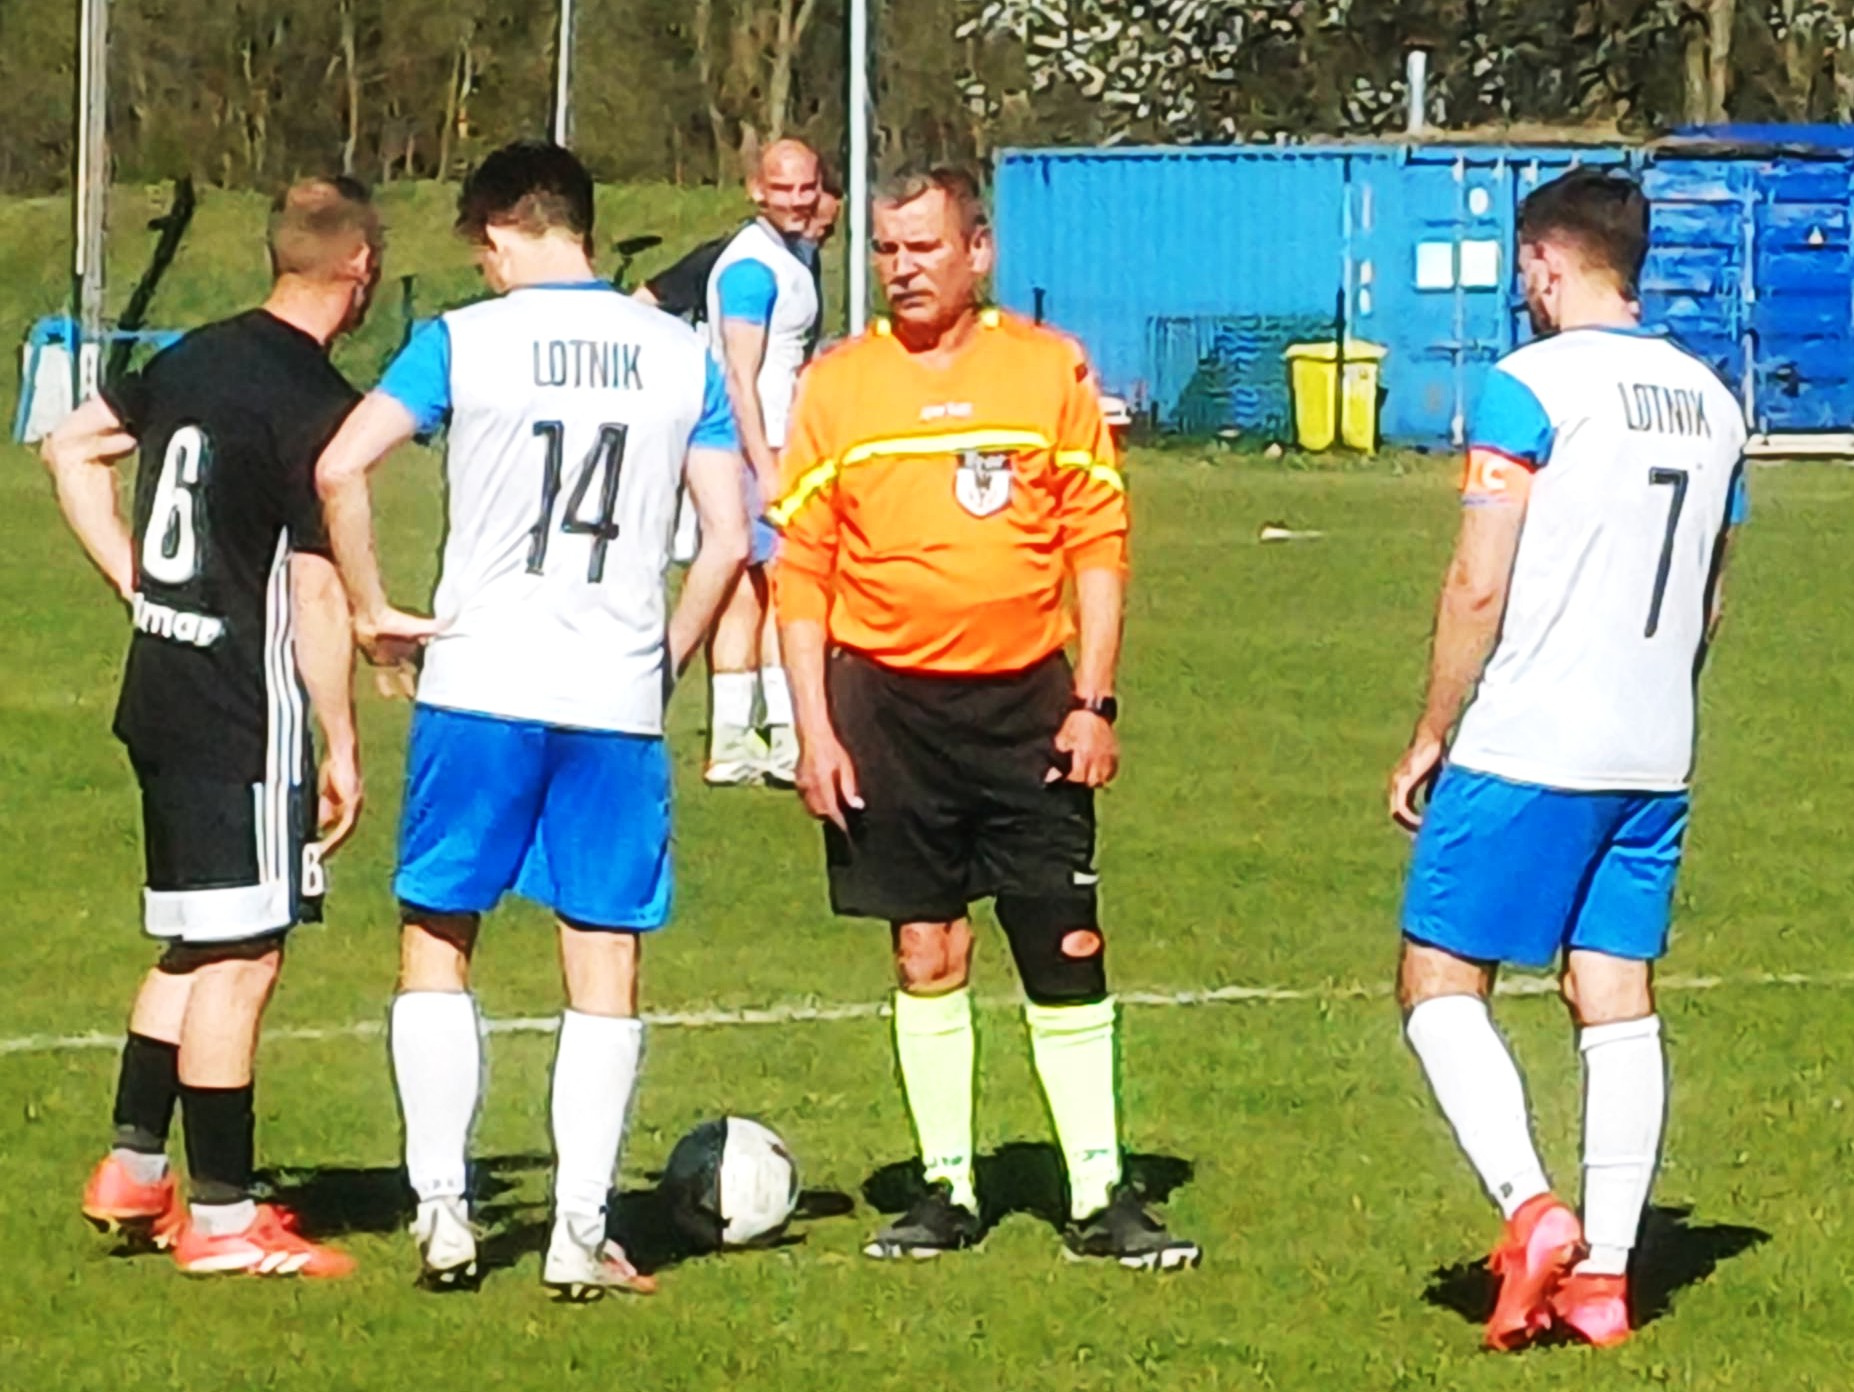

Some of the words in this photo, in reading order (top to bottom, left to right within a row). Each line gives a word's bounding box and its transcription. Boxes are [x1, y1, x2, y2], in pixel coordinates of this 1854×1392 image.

[532, 338, 643, 391] LOTNIK
[1617, 381, 1711, 438] LOTNIK
[141, 424, 204, 584] 6
[525, 419, 628, 584] 14
[1644, 466, 1689, 638] 7
